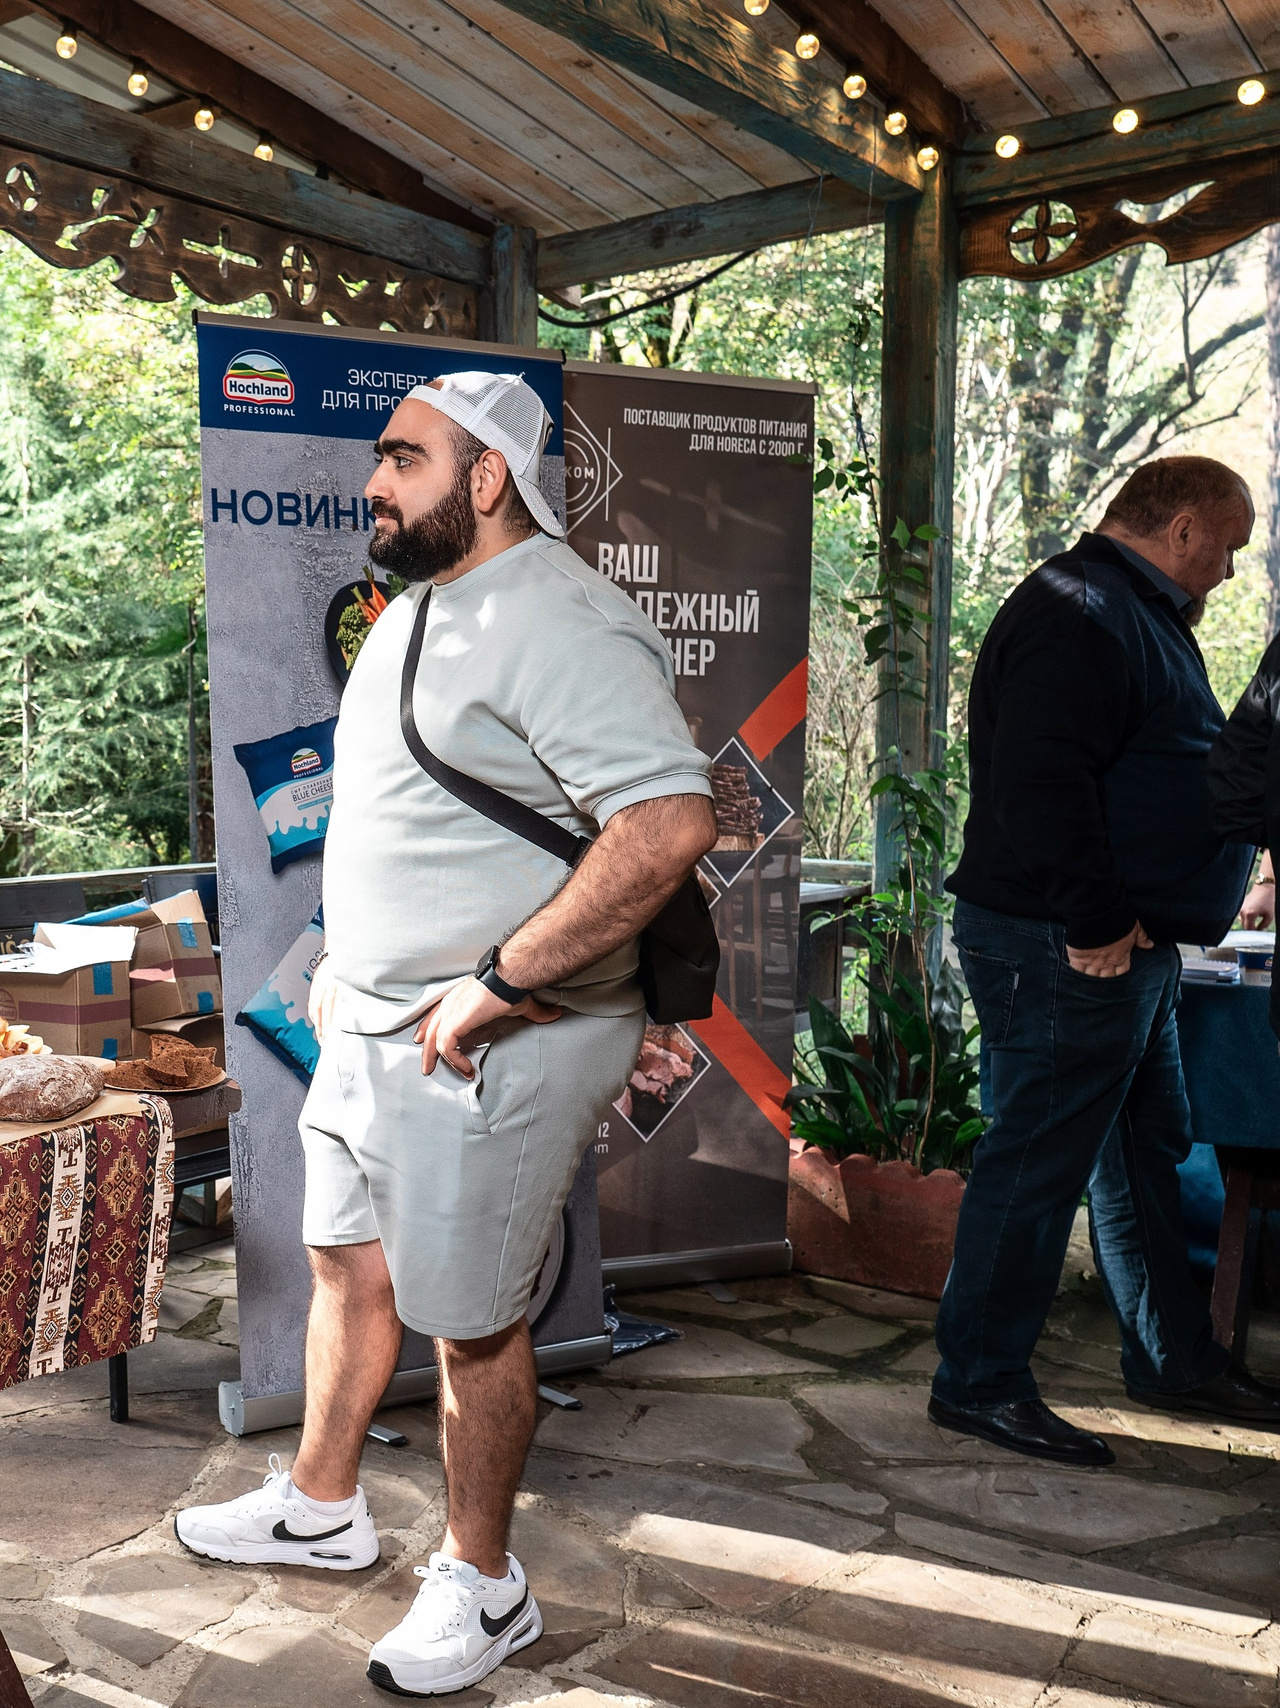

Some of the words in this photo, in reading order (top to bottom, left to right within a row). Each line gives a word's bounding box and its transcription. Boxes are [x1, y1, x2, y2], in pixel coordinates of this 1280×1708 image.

[229, 380, 288, 397] Hochland
[348, 368, 427, 391] ЭКСПЕРТ
[224, 403, 296, 417] PROFESSIONAL
[322, 389, 360, 410] ДЛЯ
[624, 408, 691, 429] ПОСТАВЩИК
[693, 414, 756, 434] ПРОДУКТОВ
[759, 420, 807, 438] ПИТАНИЯ
[689, 434, 714, 451] ДЛЯ
[717, 437, 756, 454] HORECA
[759, 439, 766, 455] С
[768, 442, 795, 457] 2000
[598, 542, 659, 583] ВАШ
[626, 590, 760, 633] ДЕЖНЫЙ
[294, 757, 319, 770] Hochland
[292, 791, 309, 802] BLUE
[595, 1143, 609, 1154] m
